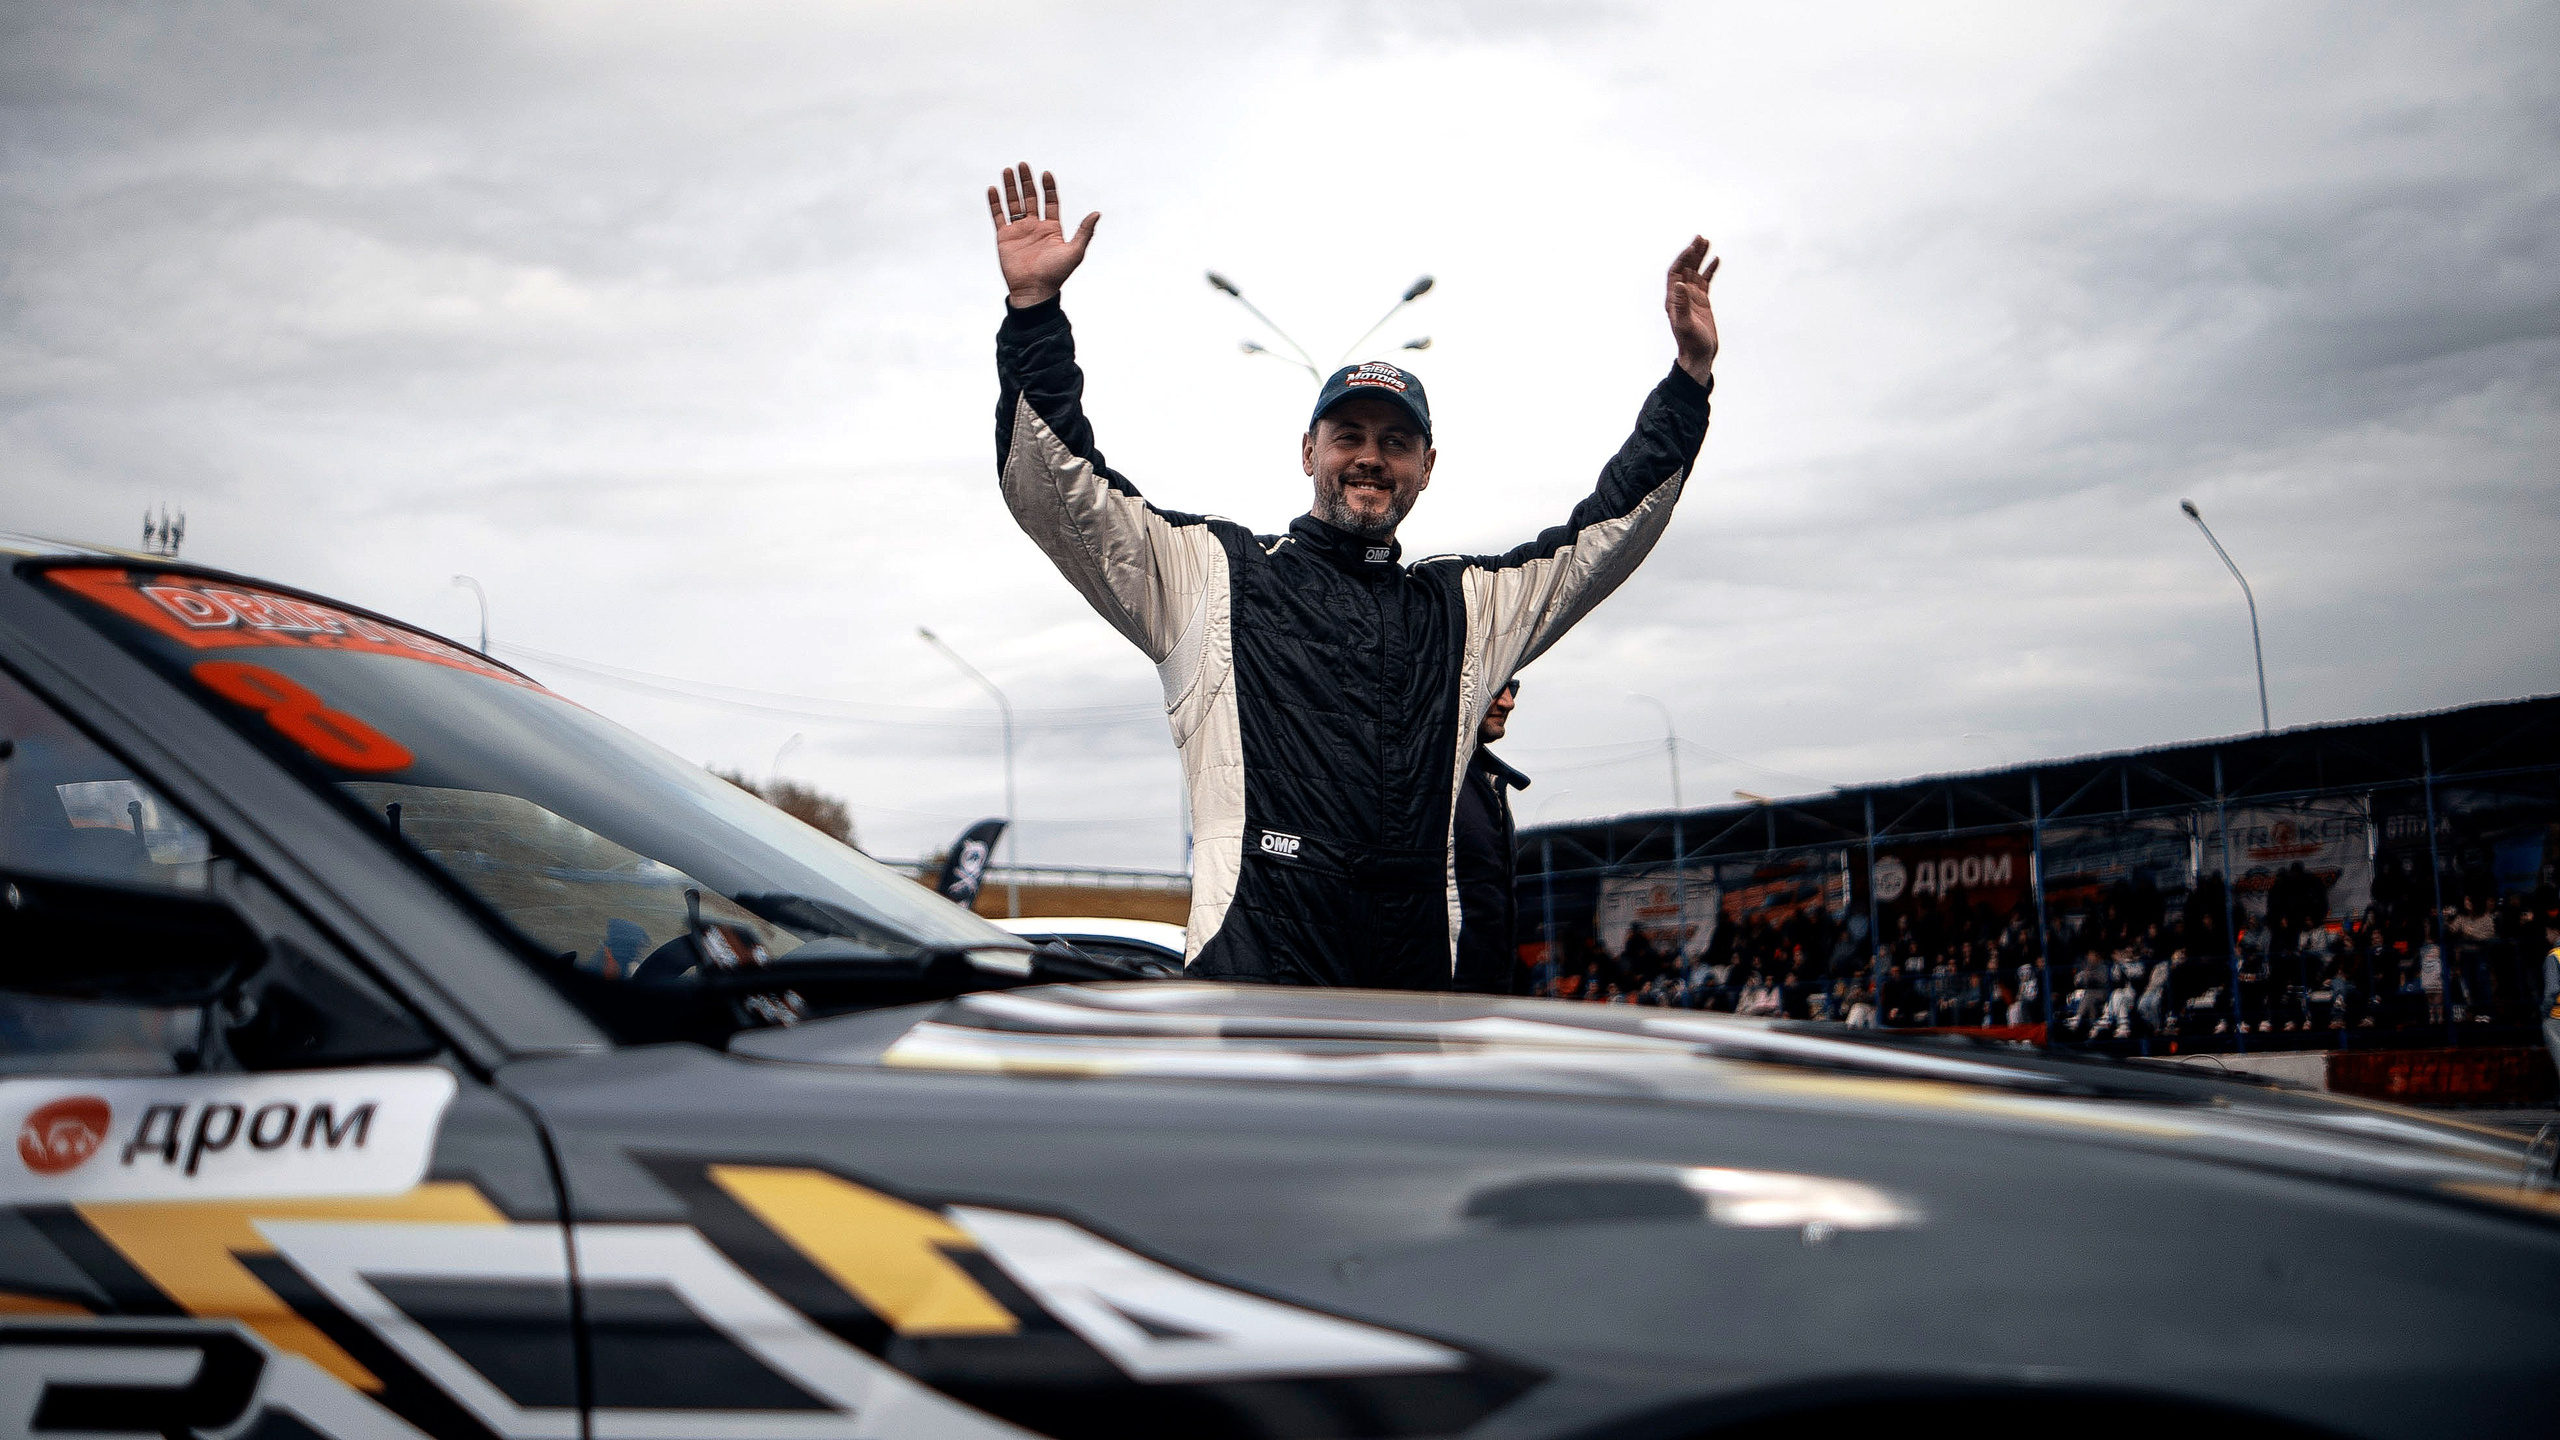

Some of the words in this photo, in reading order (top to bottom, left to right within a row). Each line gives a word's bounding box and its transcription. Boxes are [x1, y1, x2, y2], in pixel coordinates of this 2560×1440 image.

[1346, 371, 1407, 389] MOTORS
[1366, 548, 1389, 560] OMP
[190, 660, 415, 774] 8
[1261, 834, 1300, 854] OMP
[120, 1101, 379, 1177] дром
